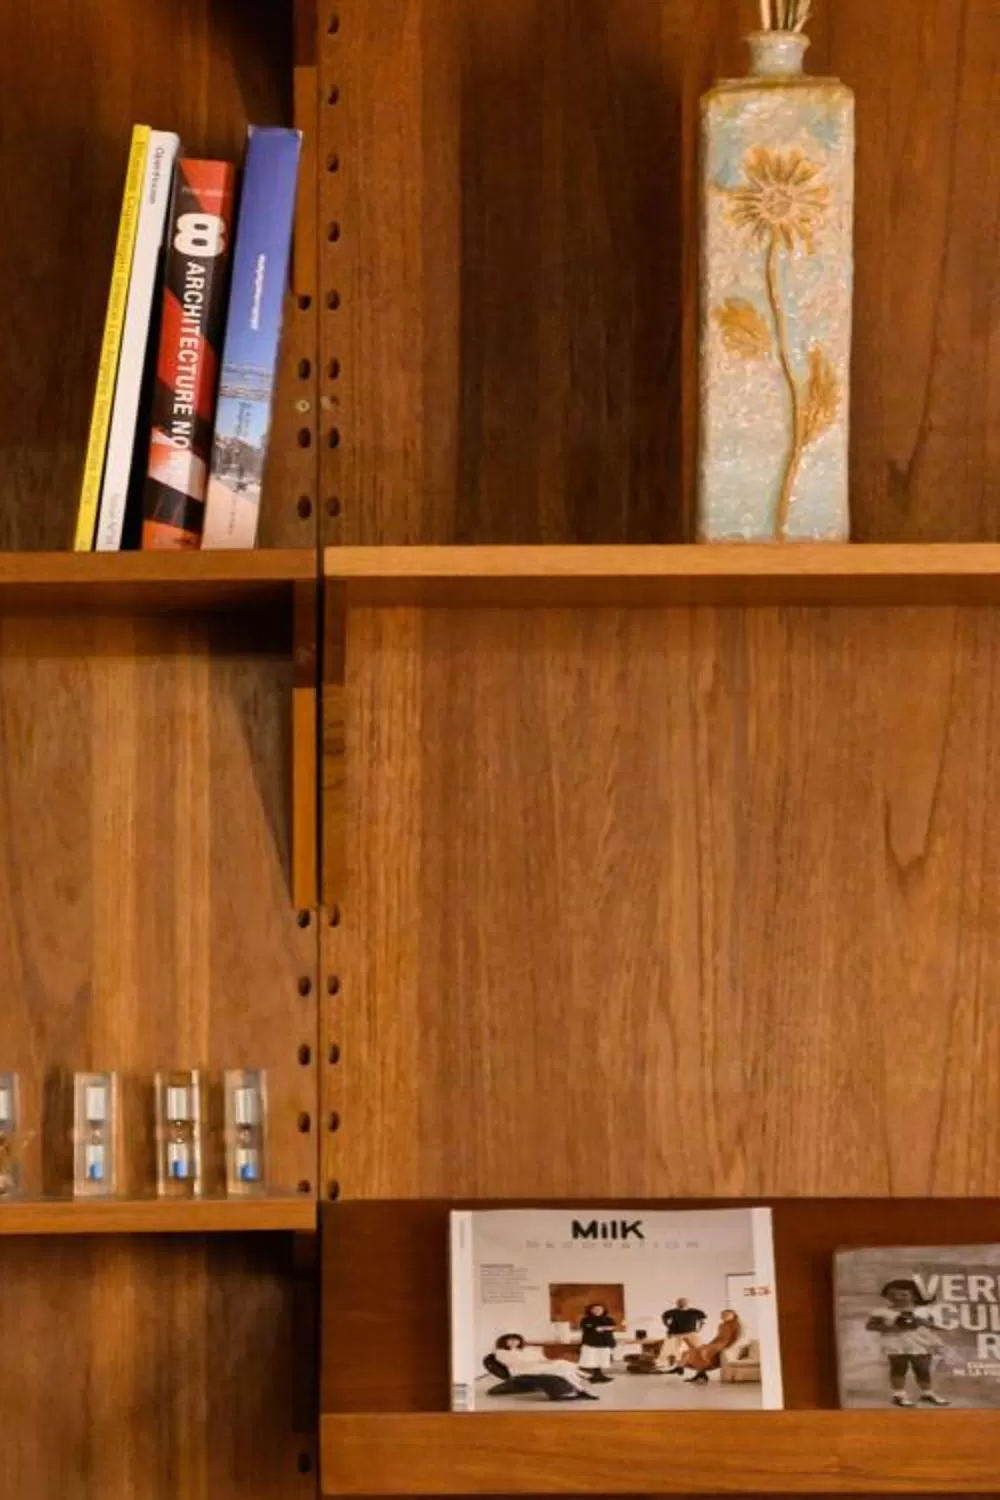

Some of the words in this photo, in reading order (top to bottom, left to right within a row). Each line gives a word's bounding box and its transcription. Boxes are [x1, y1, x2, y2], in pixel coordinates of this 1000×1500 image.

[174, 213, 225, 256] 8
[172, 261, 206, 416] ARCHITECTURE
[571, 1220, 645, 1240] MilK
[911, 1274, 1000, 1302] VER
